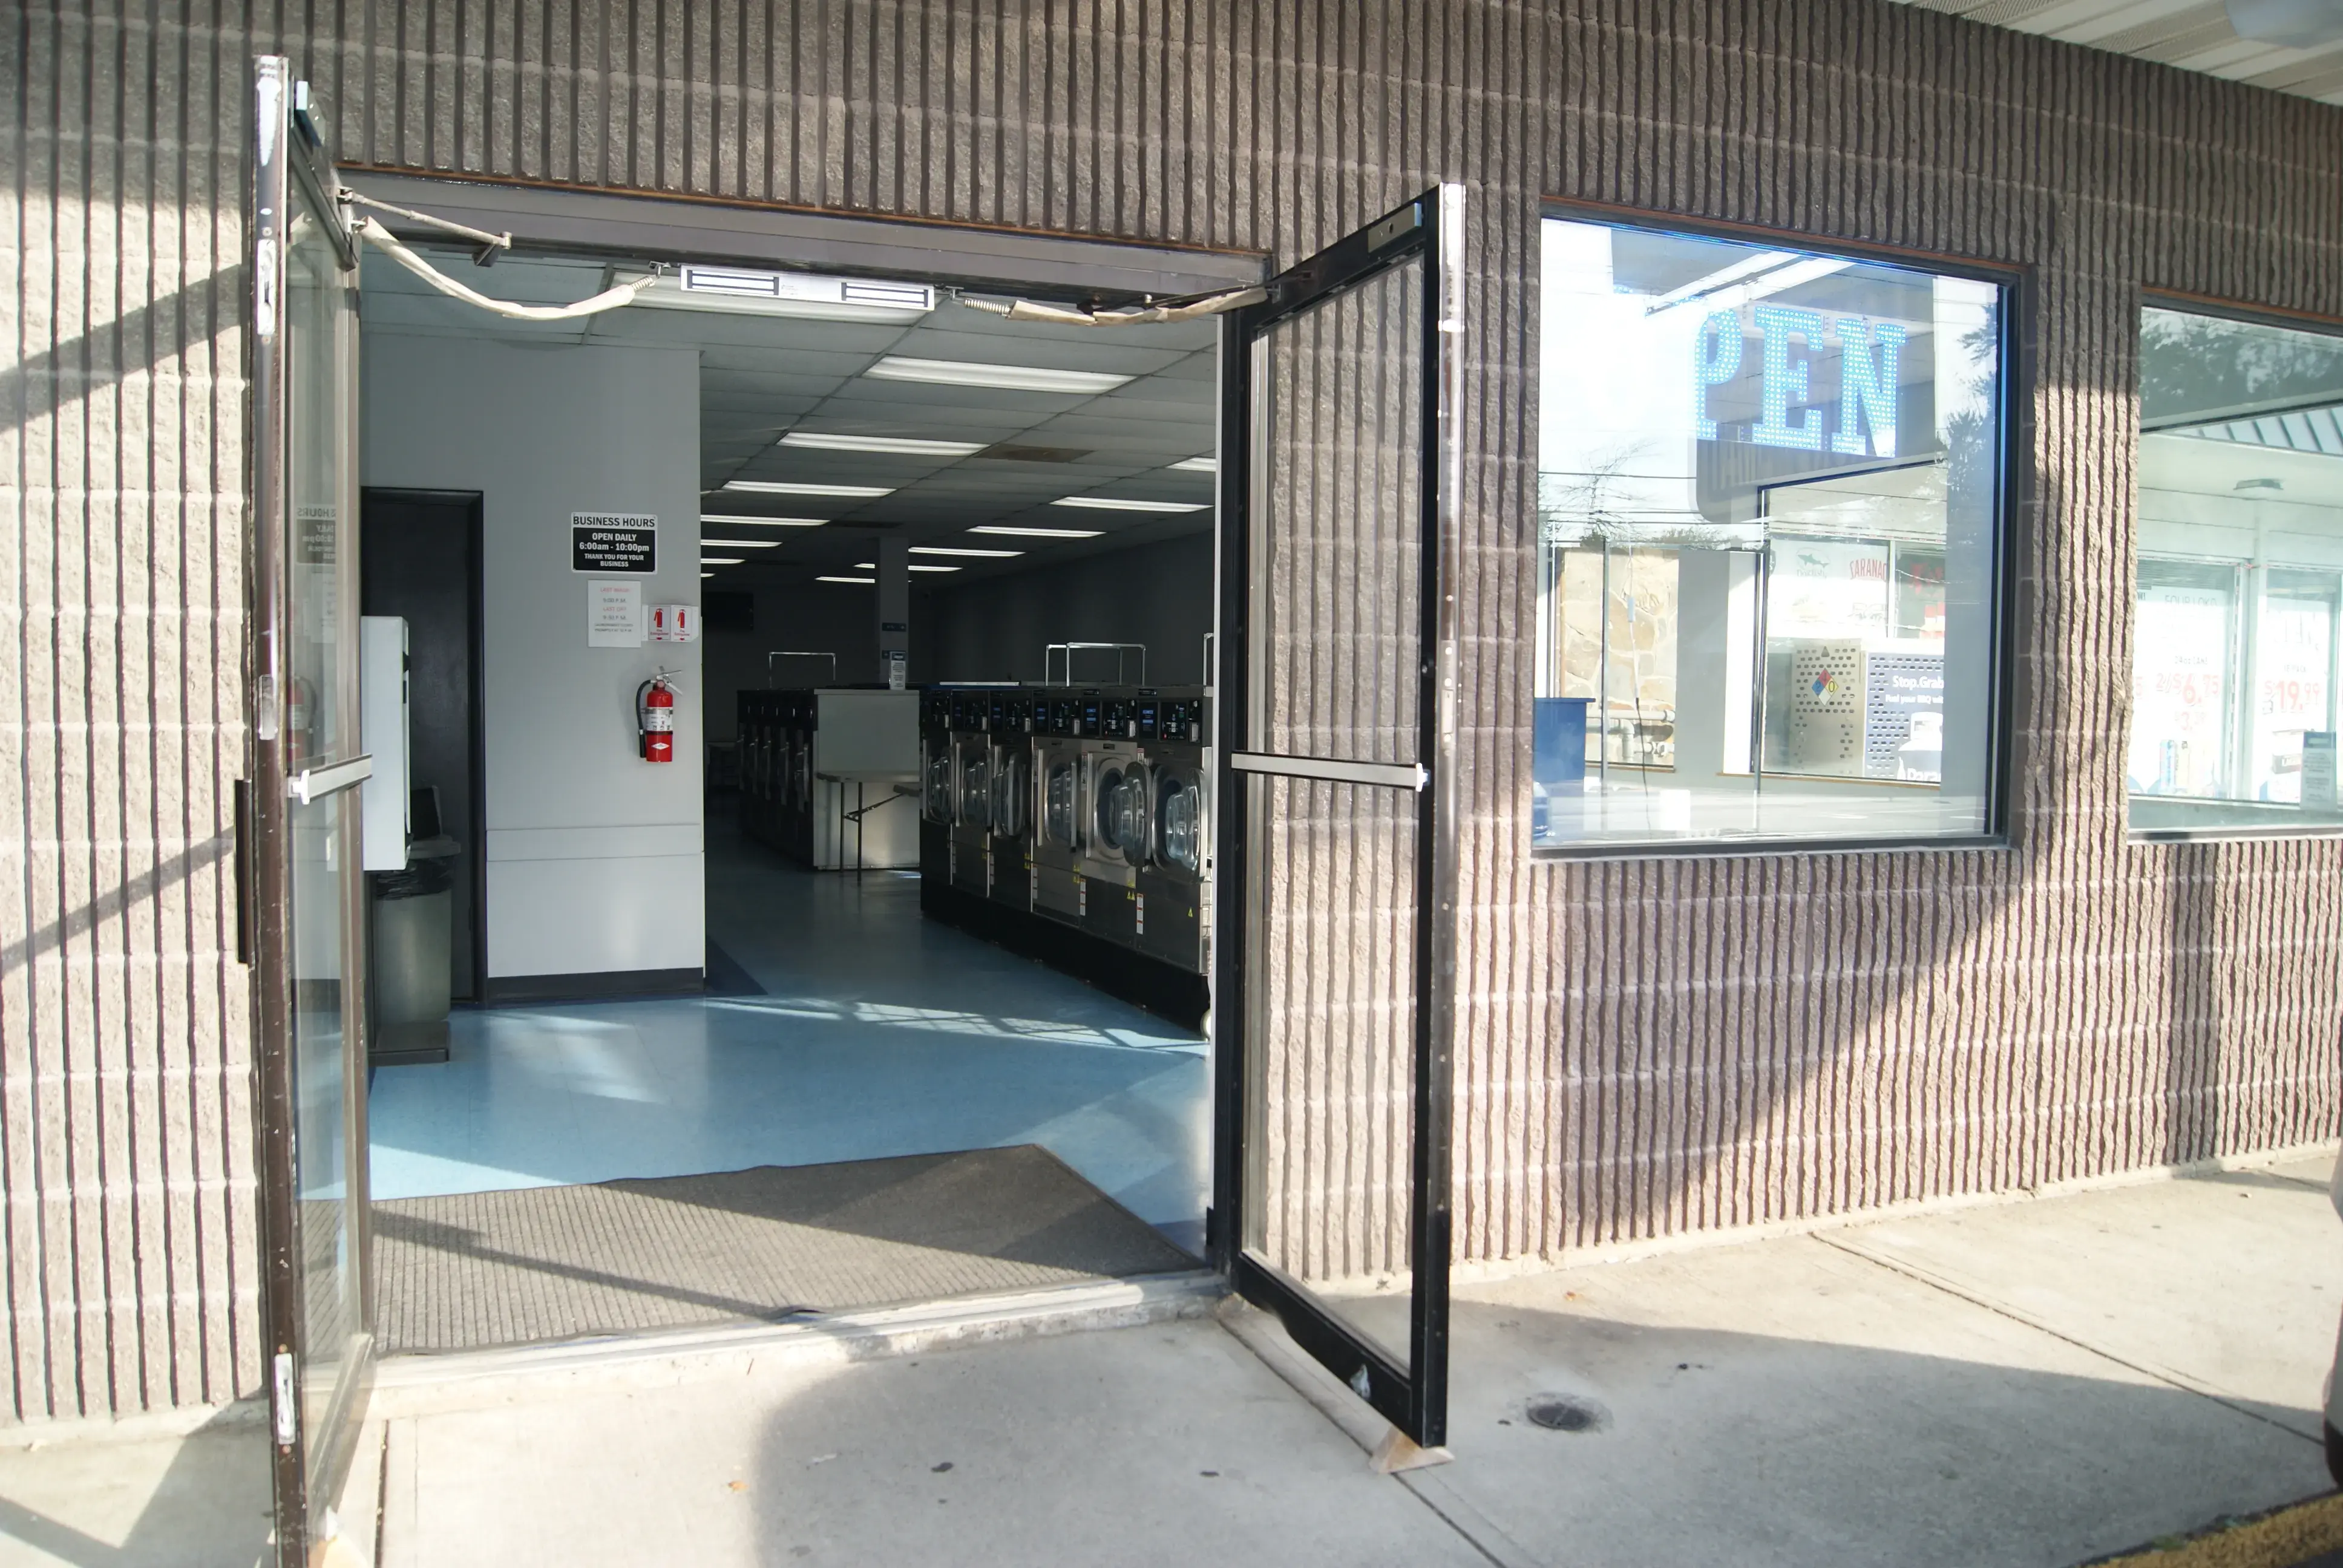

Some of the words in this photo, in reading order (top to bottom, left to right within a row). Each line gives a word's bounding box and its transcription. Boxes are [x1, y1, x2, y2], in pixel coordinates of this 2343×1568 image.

[1676, 299, 1906, 458] PEN
[573, 516, 620, 526] BUSINESS
[623, 518, 655, 527] HOURS
[579, 542, 609, 550] 6:00am
[615, 543, 649, 553] 10:00pm
